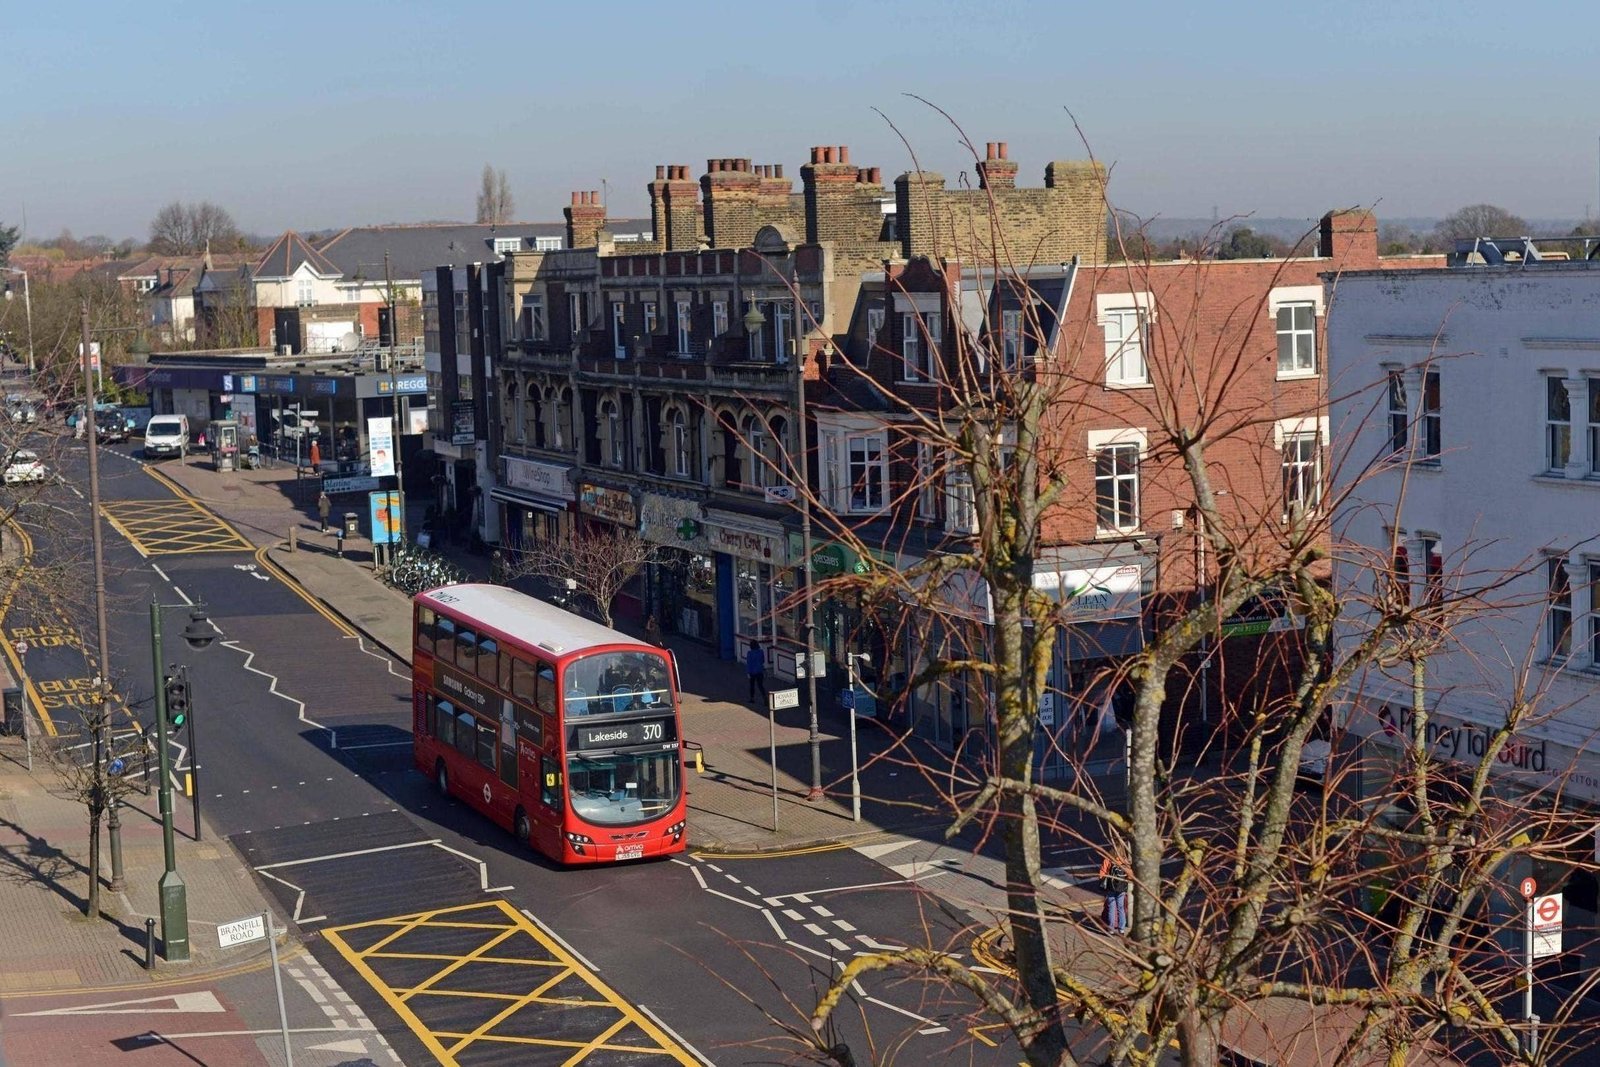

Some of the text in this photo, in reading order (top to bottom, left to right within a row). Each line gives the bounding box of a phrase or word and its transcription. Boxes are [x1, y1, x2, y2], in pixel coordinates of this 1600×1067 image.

[39, 678, 91, 693] BUS
[443, 674, 462, 693] SAMSUNG
[775, 692, 797, 701] HOWARD
[1044, 697, 1049, 706] 5
[588, 730, 628, 742] Lakeside
[643, 723, 662, 740] 370
[1400, 707, 1462, 758] Piney
[1525, 882, 1532, 895] B
[220, 919, 261, 936] BRANFILL
[229, 929, 254, 941] ROAD
